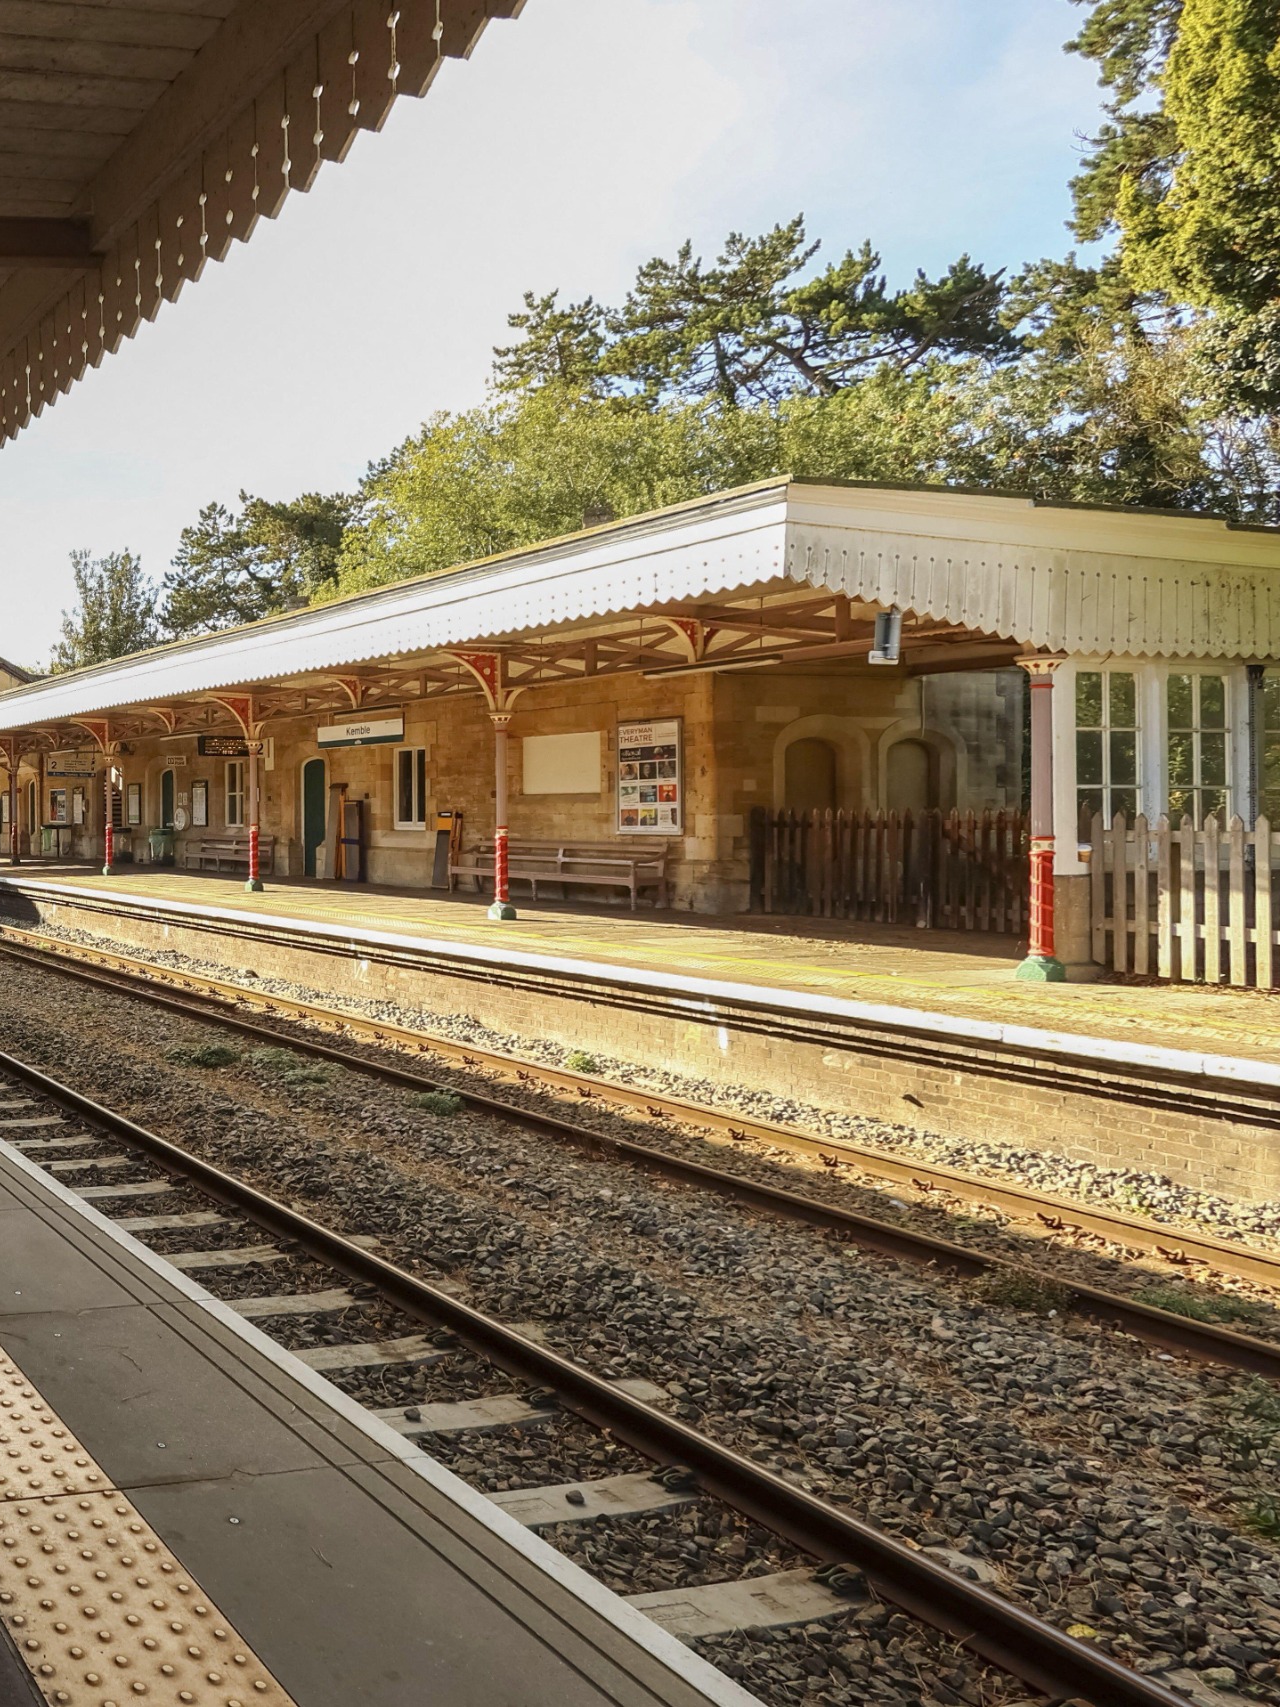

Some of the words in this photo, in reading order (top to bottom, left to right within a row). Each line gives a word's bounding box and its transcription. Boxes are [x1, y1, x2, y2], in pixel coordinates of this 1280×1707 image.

[346, 725, 371, 736] Kemble
[619, 727, 653, 736] EVERYMAN
[619, 734, 653, 744] THEATRE
[51, 760, 57, 770] 2
